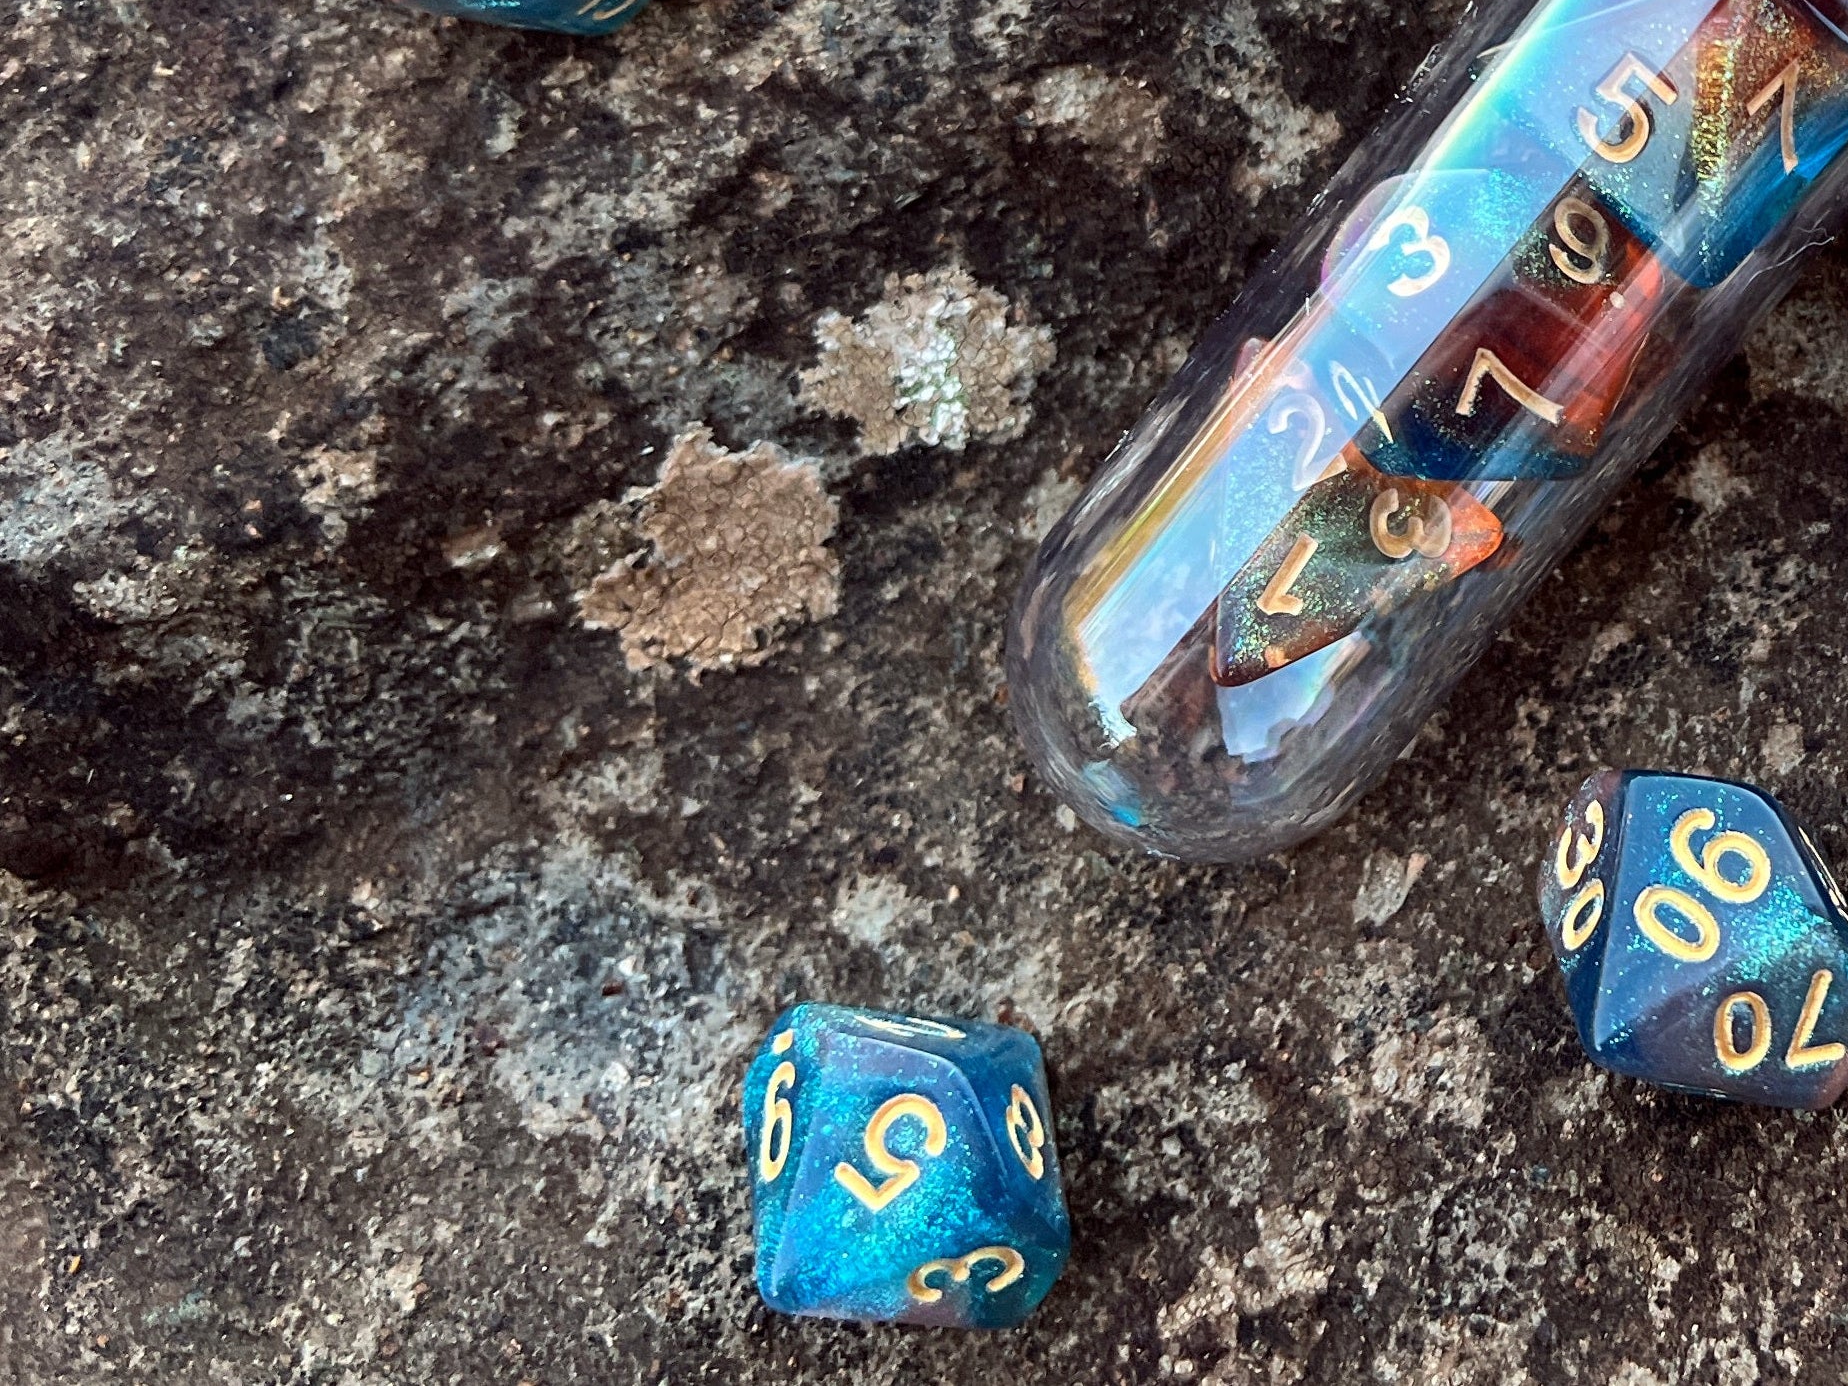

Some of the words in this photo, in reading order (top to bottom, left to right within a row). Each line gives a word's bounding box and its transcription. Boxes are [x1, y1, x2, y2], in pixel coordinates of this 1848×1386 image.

[1576, 50, 1679, 164] 5
[1368, 204, 1451, 297] 3
[1455, 347, 1565, 426] 7
[1268, 393, 1348, 492] 2
[1370, 487, 1453, 559] 3
[1556, 799, 1605, 952] 30
[1633, 807, 1772, 963] 90
[1713, 969, 1848, 1072] 70
[834, 1093, 948, 1212] 5
[907, 1245, 1026, 1304] 3
